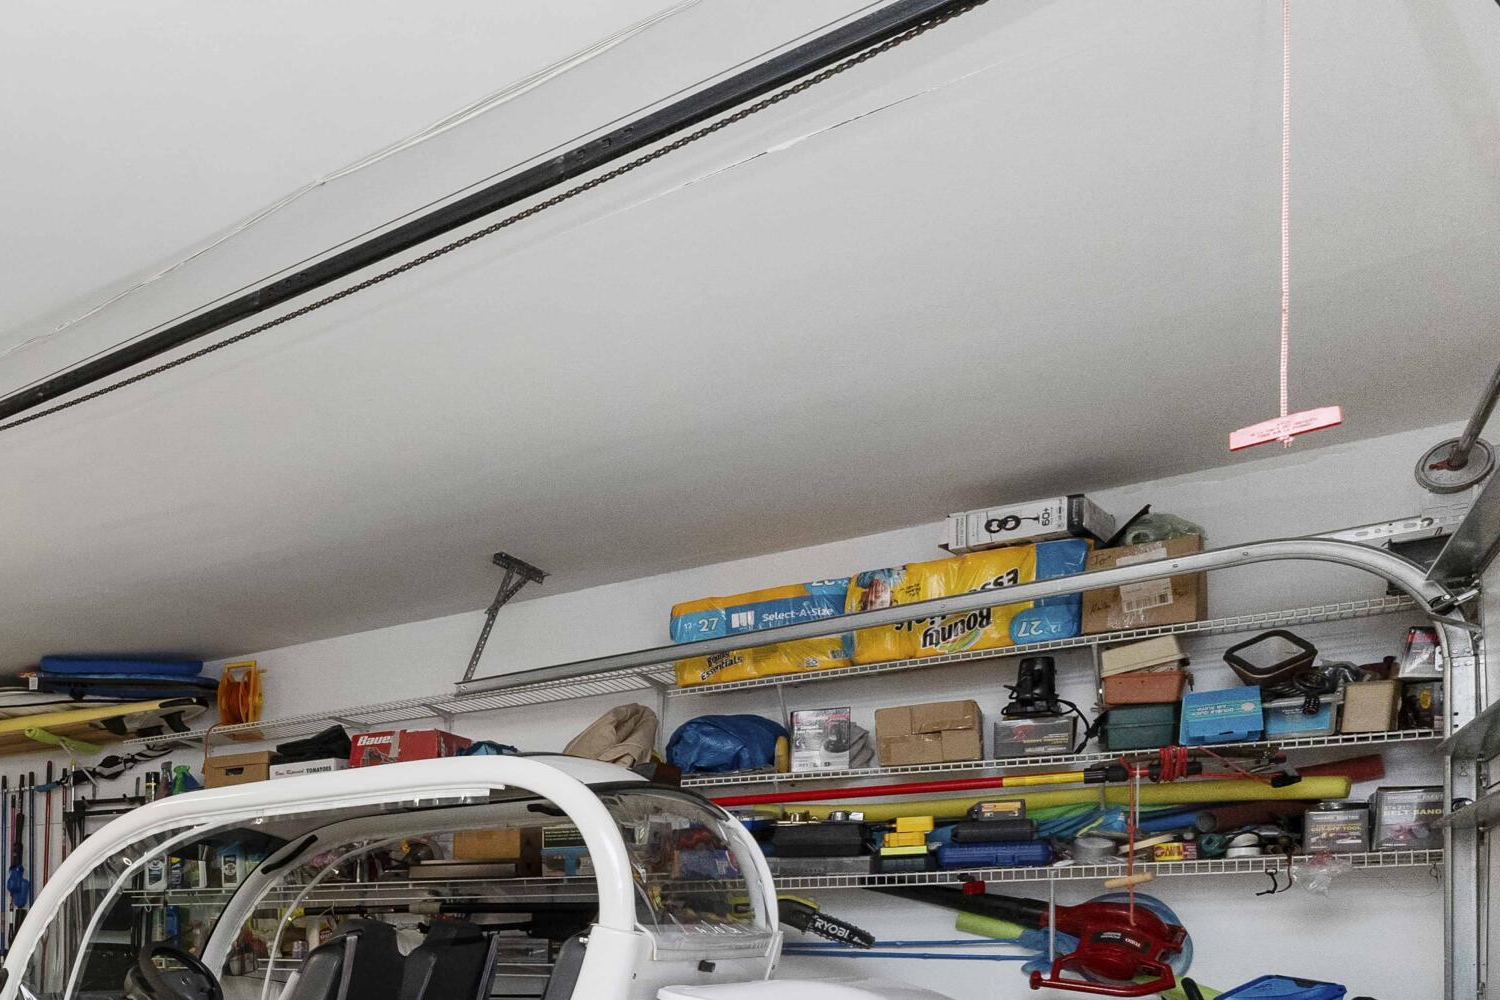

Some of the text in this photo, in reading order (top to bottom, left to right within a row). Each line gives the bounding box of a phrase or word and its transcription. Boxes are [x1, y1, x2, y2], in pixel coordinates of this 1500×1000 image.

[761, 607, 834, 622] Select-A-Size
[699, 617, 719, 632] 27
[921, 608, 992, 649] Bounty
[1018, 620, 1044, 637] 27
[701, 656, 743, 681] Essentials
[306, 765, 332, 774] TOMATOES
[814, 918, 850, 939] RYOBI
